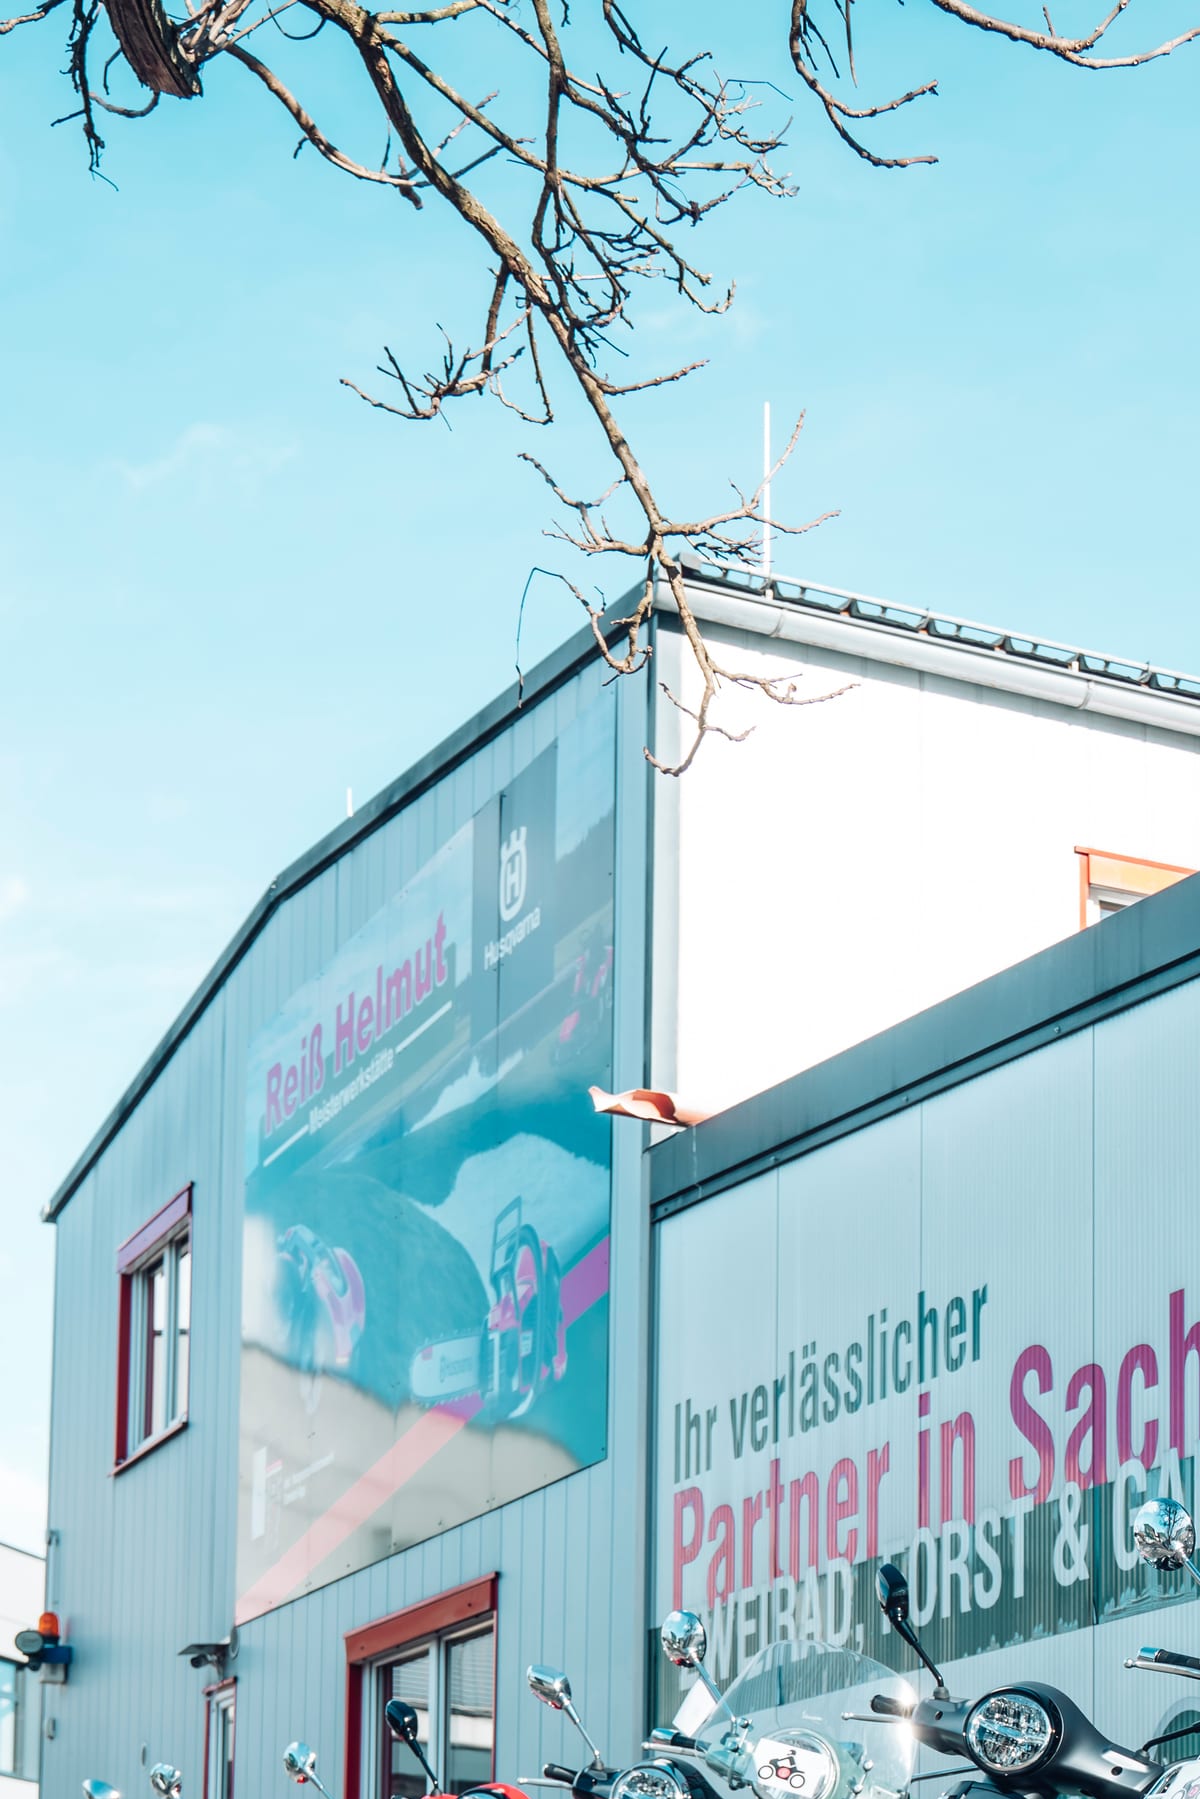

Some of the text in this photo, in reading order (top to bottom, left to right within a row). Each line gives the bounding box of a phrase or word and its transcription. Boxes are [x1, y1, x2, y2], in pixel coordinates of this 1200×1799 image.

[265, 908, 447, 1137] Reiß Helmut
[483, 906, 541, 971] Husqvarna
[308, 1047, 395, 1136] Meisterwerkstätte
[674, 1283, 988, 1485] Ihr verlässlicher
[669, 1556, 865, 1692] WEIRAD,
[1053, 1480, 1090, 1587] &
[672, 1440, 890, 1613] Partner
[917, 1391, 975, 1536] in
